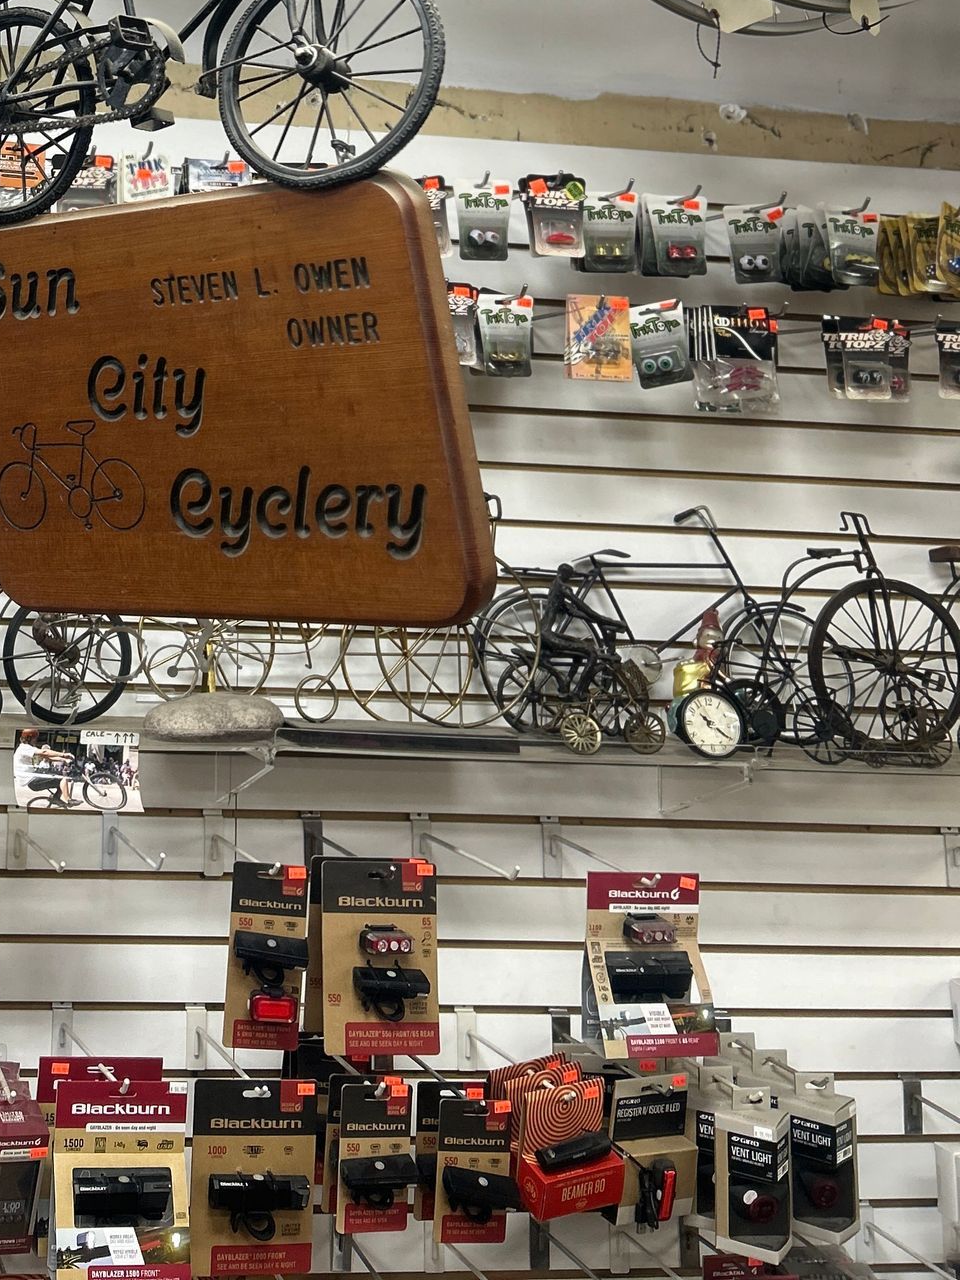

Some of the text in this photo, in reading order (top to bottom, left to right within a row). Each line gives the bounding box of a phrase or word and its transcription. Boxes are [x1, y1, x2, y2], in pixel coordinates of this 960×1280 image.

[535, 197, 580, 206] TOPZ
[150, 255, 371, 309] STEVEN L. OWEN
[286, 311, 381, 350] OWNER
[87, 352, 208, 439] City
[170, 464, 429, 562] Cyclery
[608, 890, 670, 899] Blackburn
[239, 898, 302, 910] Blackburn
[338, 895, 423, 908] Blackburn
[238, 917, 252, 926] 550
[327, 994, 341, 1003] 550
[71, 1103, 171, 1116] Blackburn
[617, 1106, 641, 1118] REGISTER
[210, 1118, 303, 1129] Blackburn
[346, 1122, 406, 1132] Blackburn
[443, 1137, 505, 1146] Blackburn
[792, 1128, 832, 1147] VENT LIGHT
[63, 1139, 84, 1148] 1500
[346, 1143, 360, 1152] 550
[207, 1145, 227, 1155] 1000
[731, 1145, 773, 1165] VENT LIGHT
[444, 1156, 458, 1166] 550
[561, 1179, 606, 1201] BEAMER 80
[91, 1270, 125, 1278] DAYBLAZER
